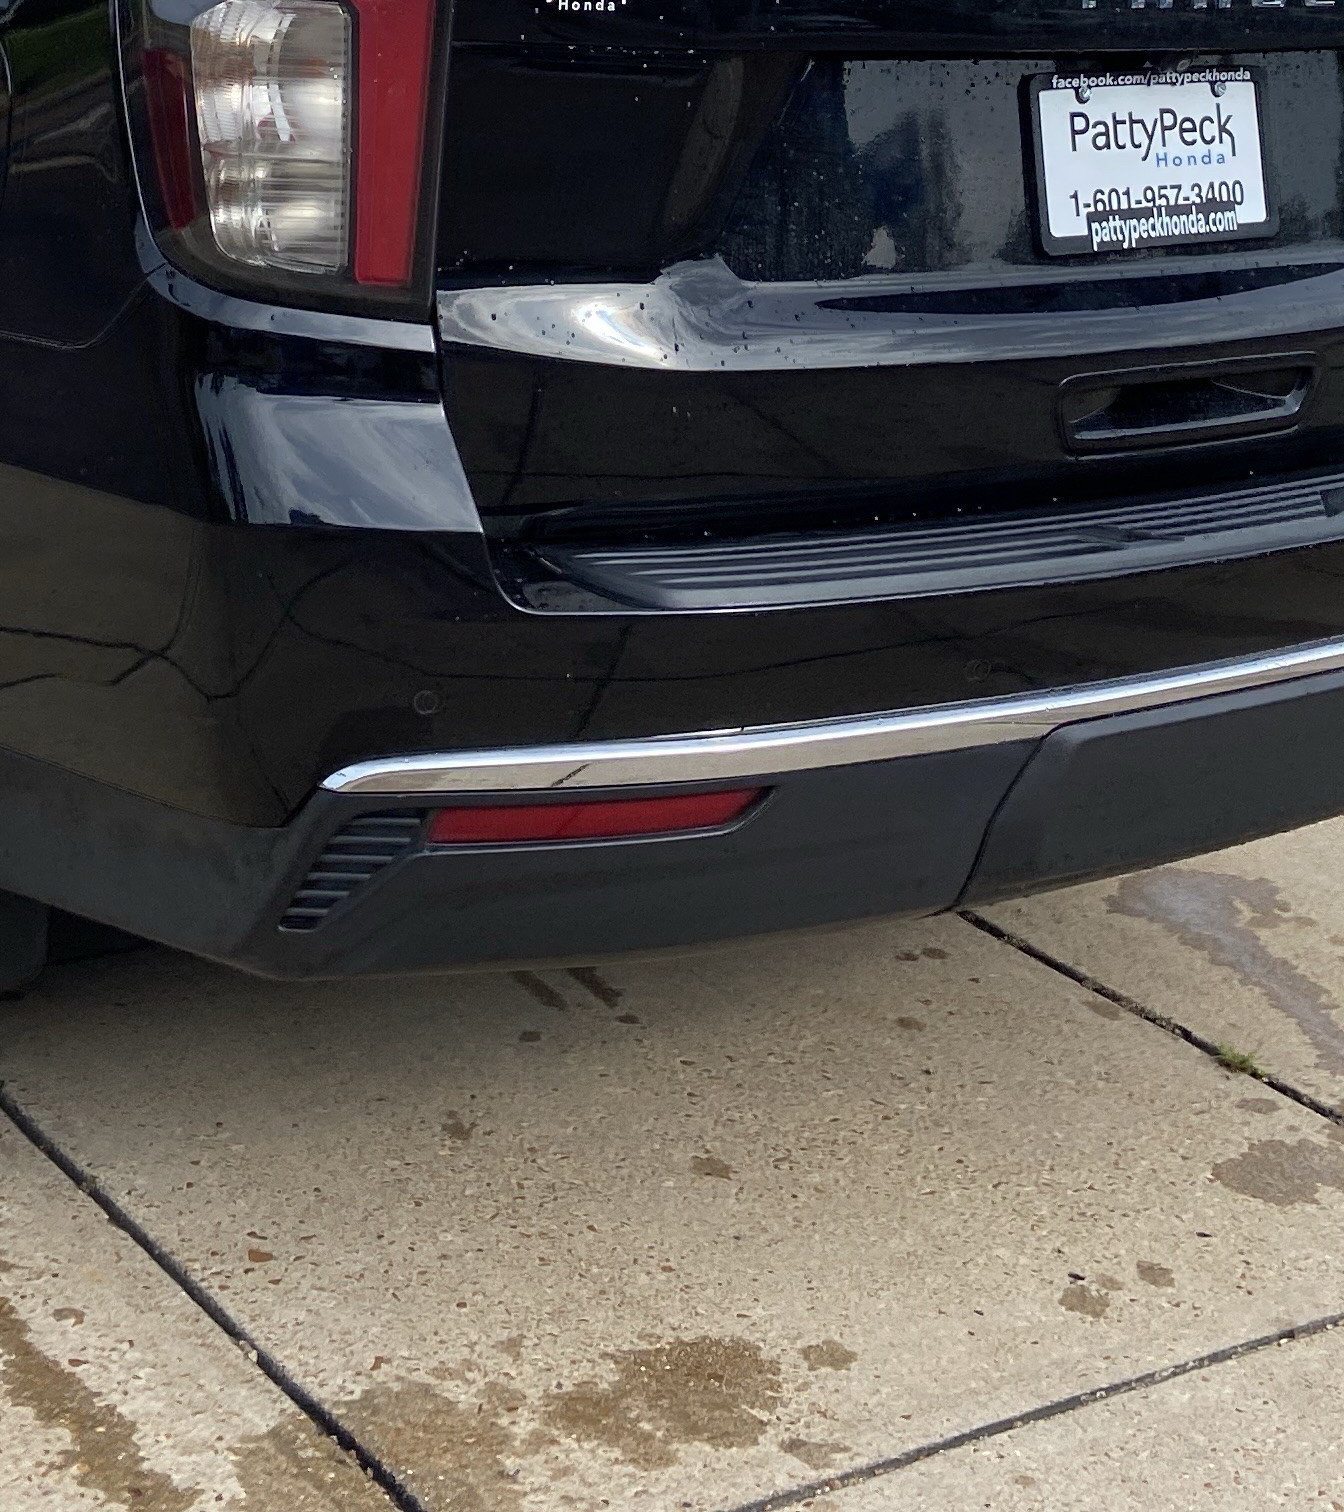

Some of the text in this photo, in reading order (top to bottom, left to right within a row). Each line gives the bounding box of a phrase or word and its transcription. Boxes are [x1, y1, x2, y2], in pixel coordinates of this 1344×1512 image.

[1051, 68, 1251, 88] facebook.com/pattypeckhonda
[1068, 102, 1237, 162] PattyPeck
[1156, 149, 1226, 168] Honda
[1068, 179, 1245, 217] 1-601-957-3400
[1090, 205, 1238, 251] pattypeckhonda.com
